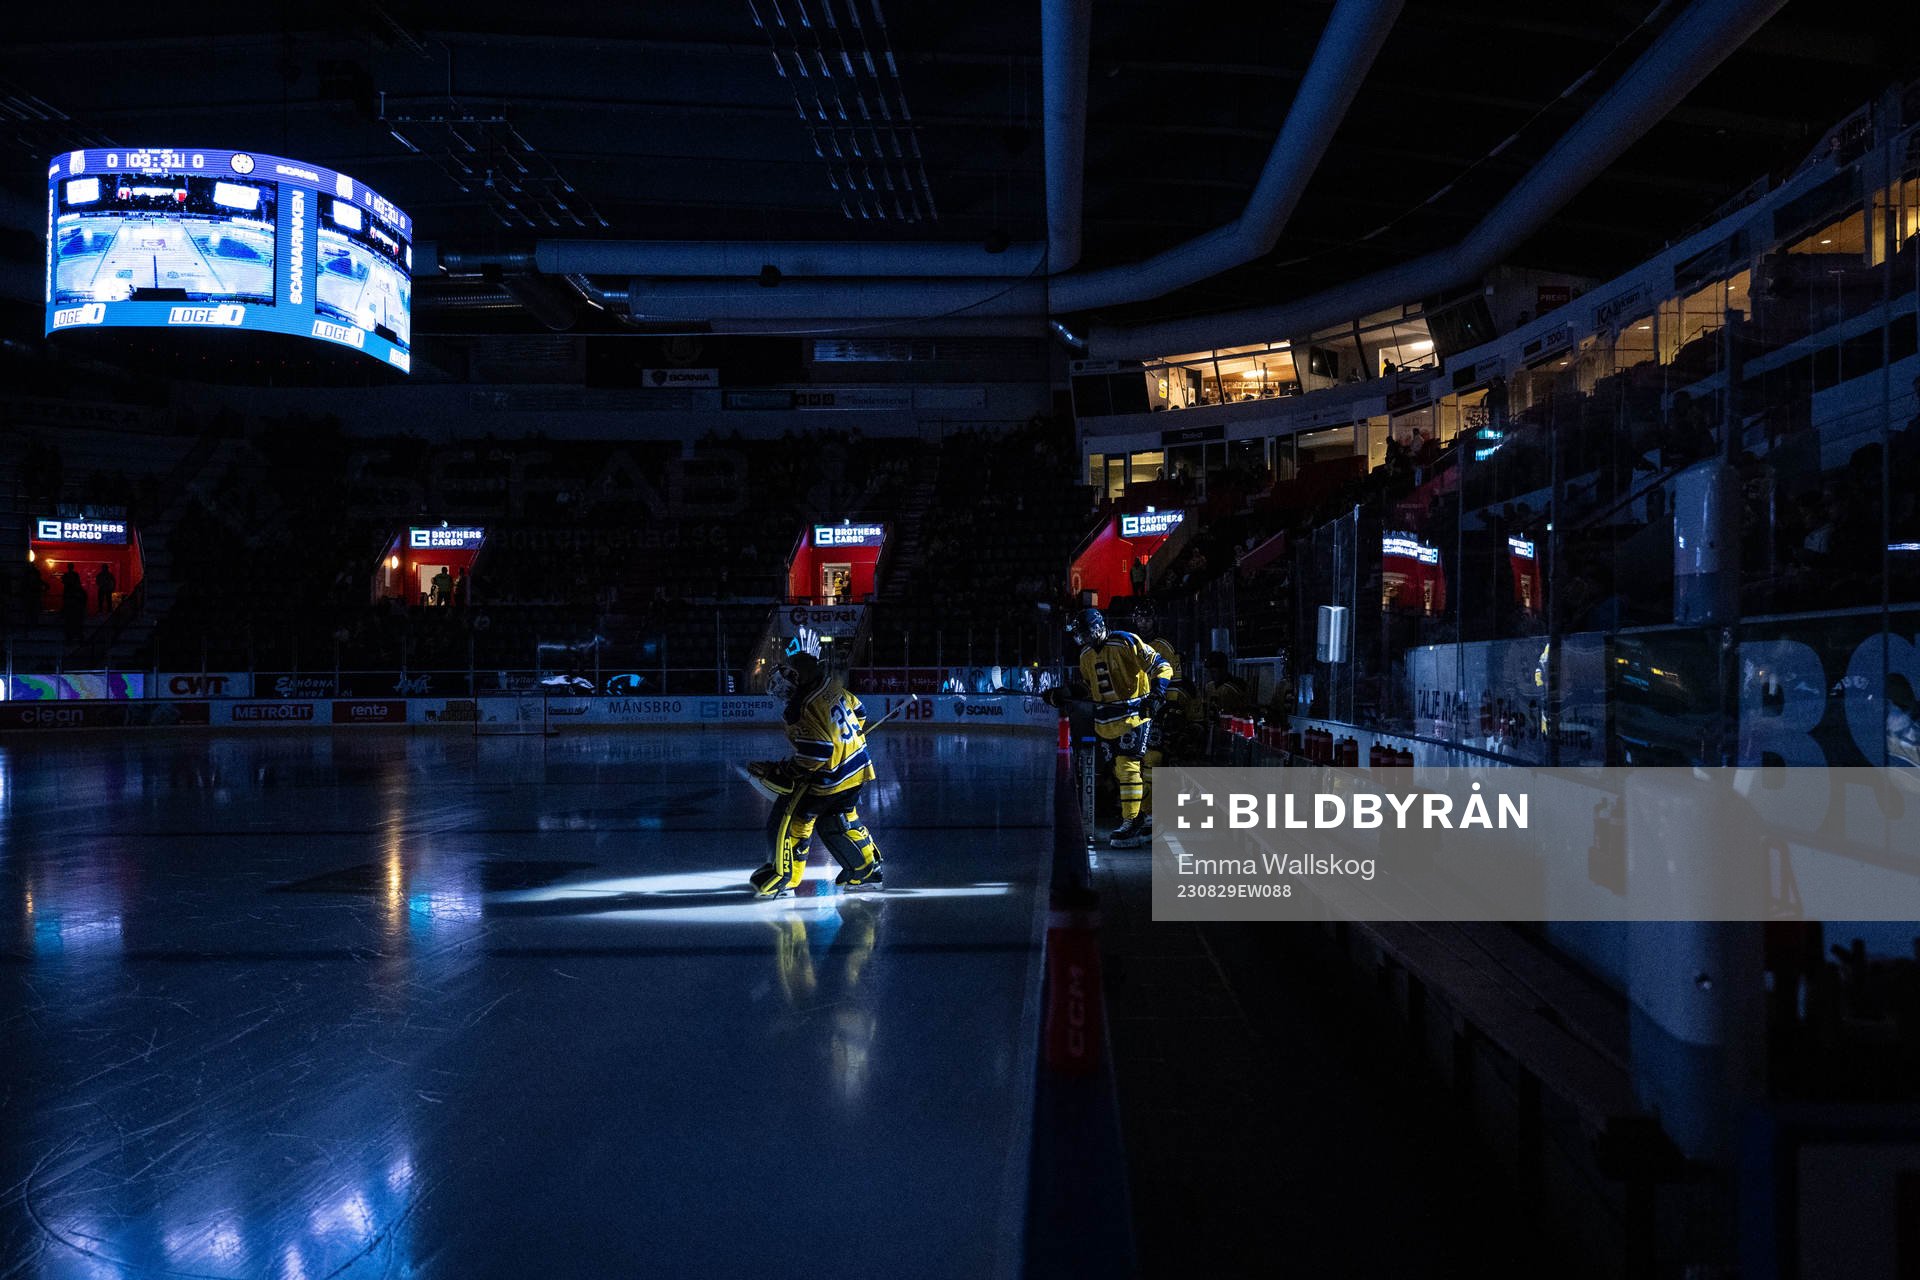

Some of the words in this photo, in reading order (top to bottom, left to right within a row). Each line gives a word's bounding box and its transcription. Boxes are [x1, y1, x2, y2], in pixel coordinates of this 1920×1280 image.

[107, 154, 118, 167] 0
[192, 154, 204, 168] 0
[669, 373, 711, 382] SCANIA
[1140, 514, 1183, 524] BROTHERS
[64, 522, 124, 533] BROTHERS
[834, 527, 882, 536] BROTHERS
[1140, 523, 1167, 532] CARGO
[64, 531, 102, 540] CARGO
[431, 530, 482, 539] BROTHERS
[834, 535, 865, 543] CARGO
[431, 538, 464, 546] CARGO
[608, 699, 682, 713] MÅNSBRO
[721, 701, 774, 709] BROTHERS
[351, 704, 389, 716] renta
[721, 709, 754, 718] CARGO
[966, 706, 1003, 716] SCANIA
[20, 707, 85, 725] clean
